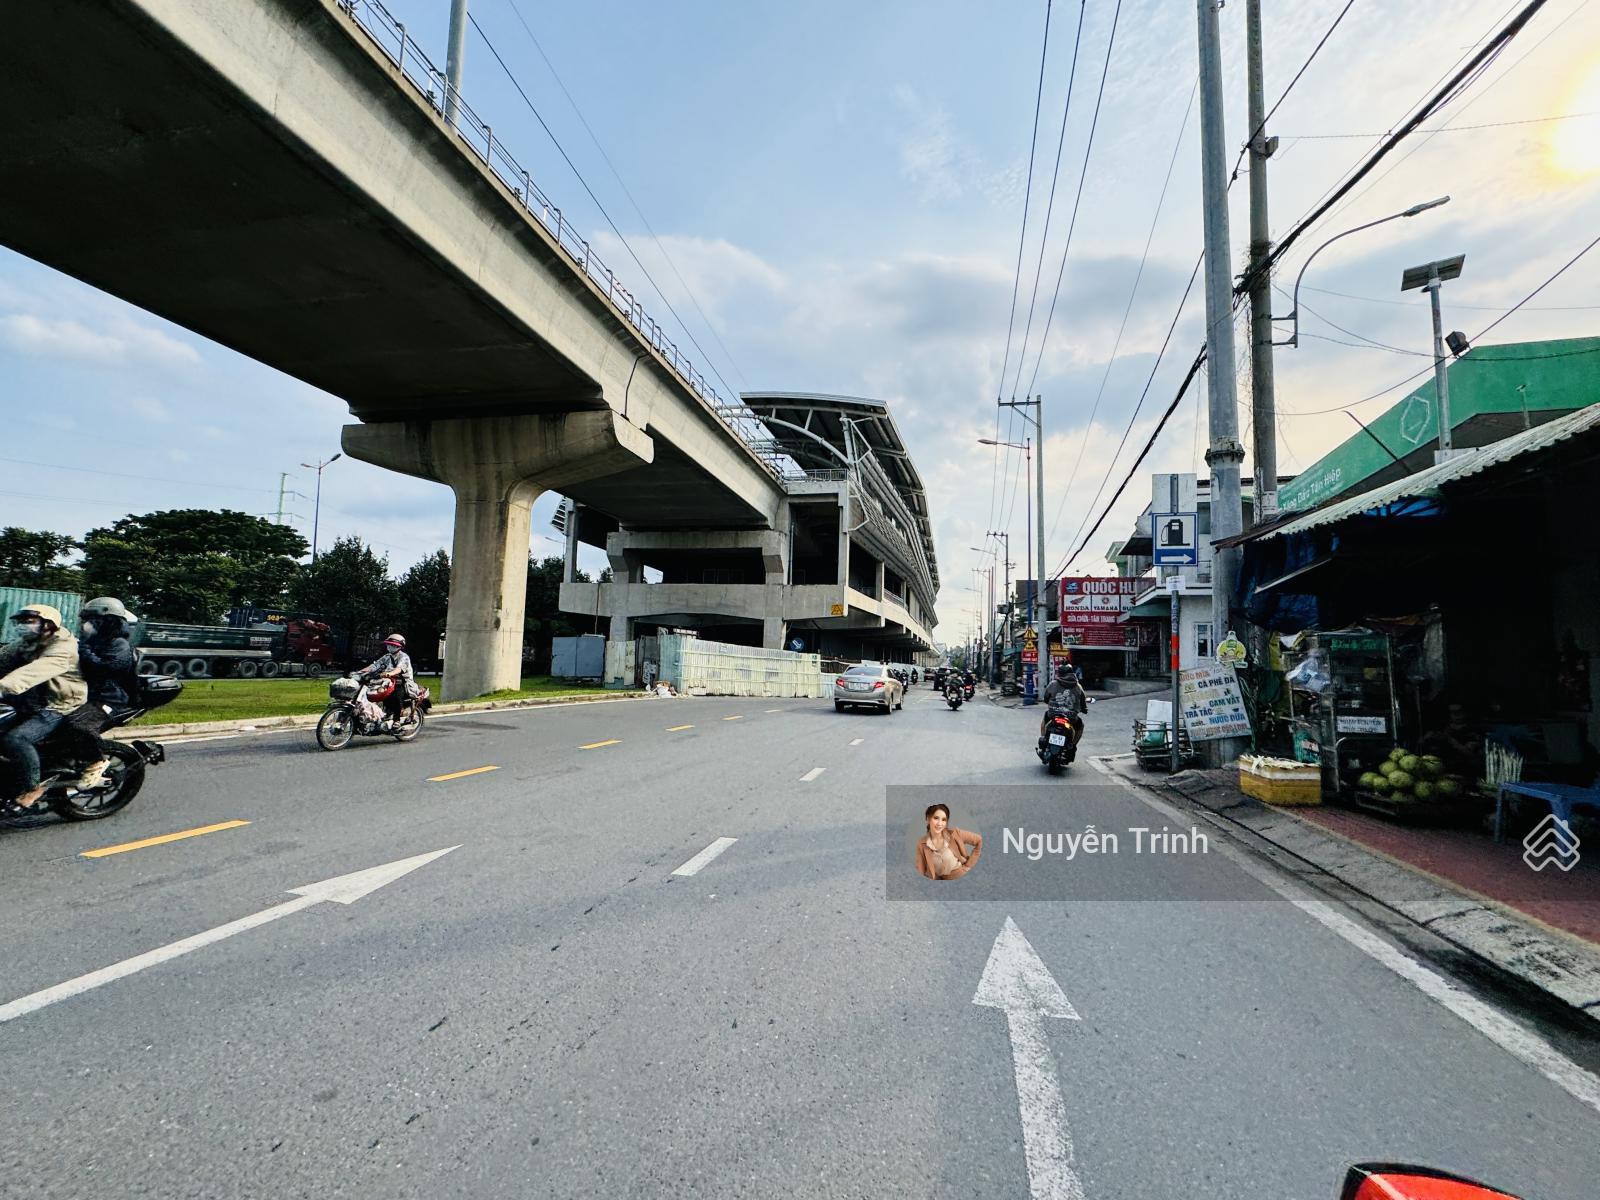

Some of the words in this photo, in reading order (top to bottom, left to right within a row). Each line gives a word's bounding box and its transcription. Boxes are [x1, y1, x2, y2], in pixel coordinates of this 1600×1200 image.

[1324, 468, 1341, 485] Hiệp
[1082, 579, 1116, 594] QUỐC
[1209, 677, 1223, 687] PHÊ
[1209, 700, 1226, 708] CAM
